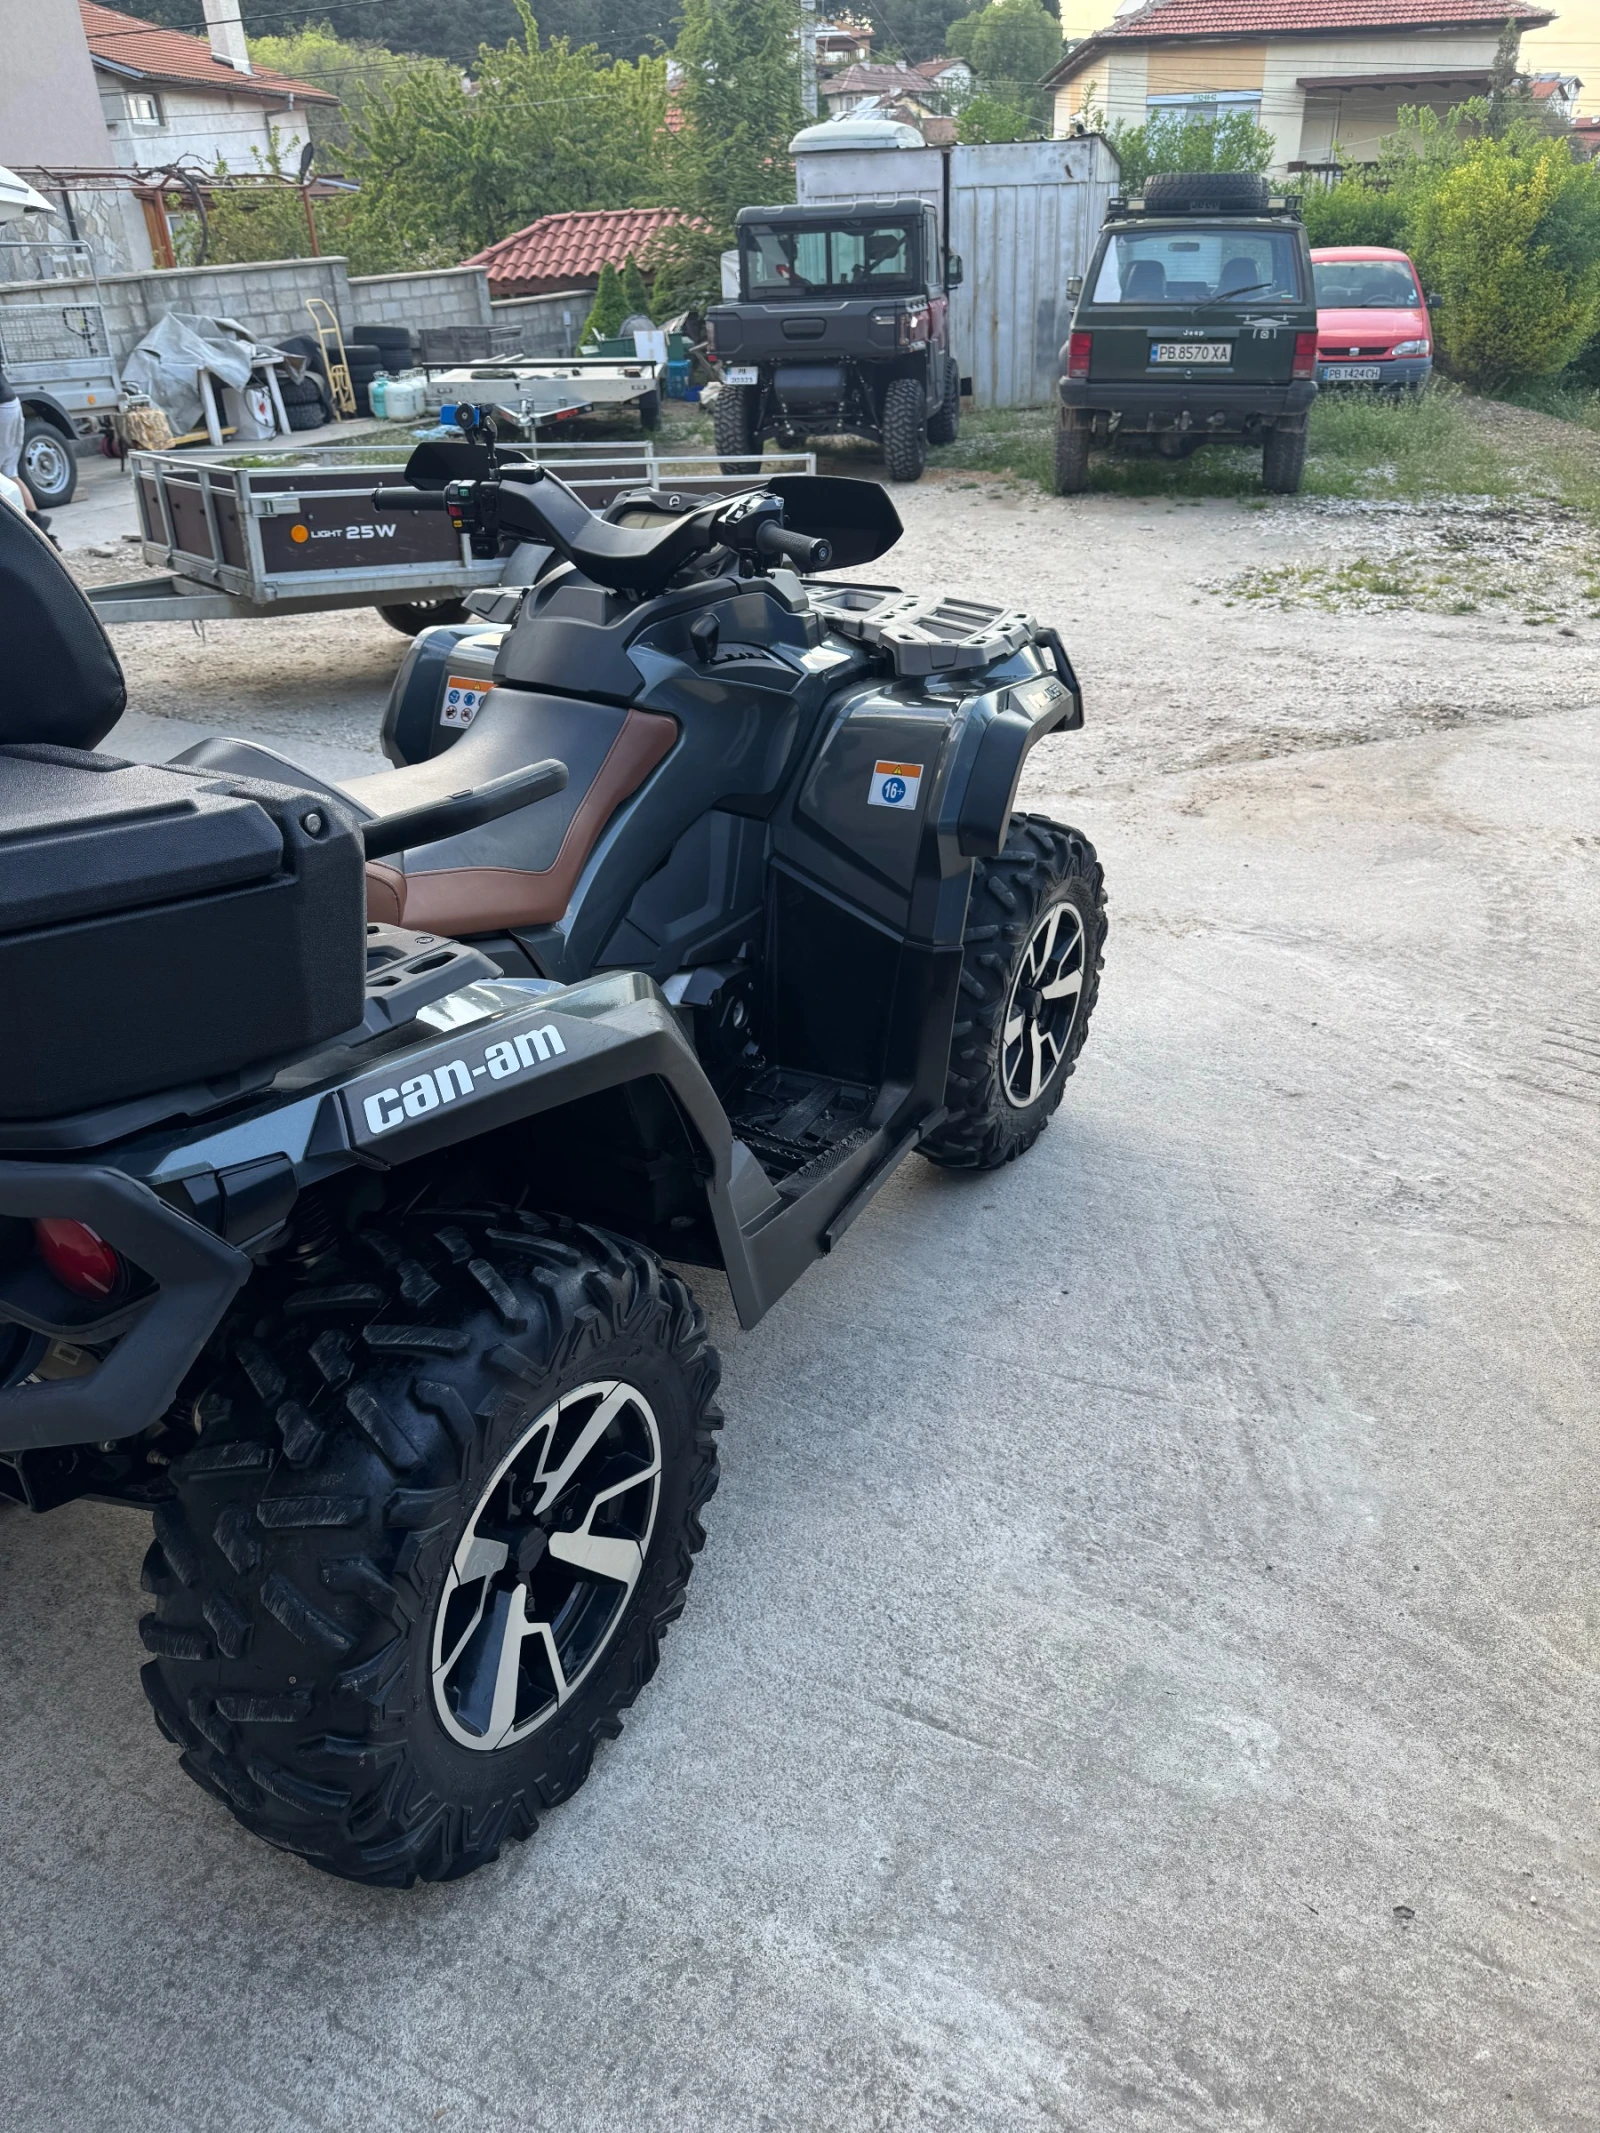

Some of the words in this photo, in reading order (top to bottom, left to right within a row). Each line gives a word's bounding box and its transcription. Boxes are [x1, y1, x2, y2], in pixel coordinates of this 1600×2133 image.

[1182, 329, 1205, 337] Jeep
[1159, 346, 1176, 360] PB
[1178, 346, 1209, 360] 8570
[1212, 346, 1228, 359] XA
[310, 529, 343, 539] LIGHT
[885, 782, 904, 798] 16+
[362, 1023, 567, 1135] can-am
